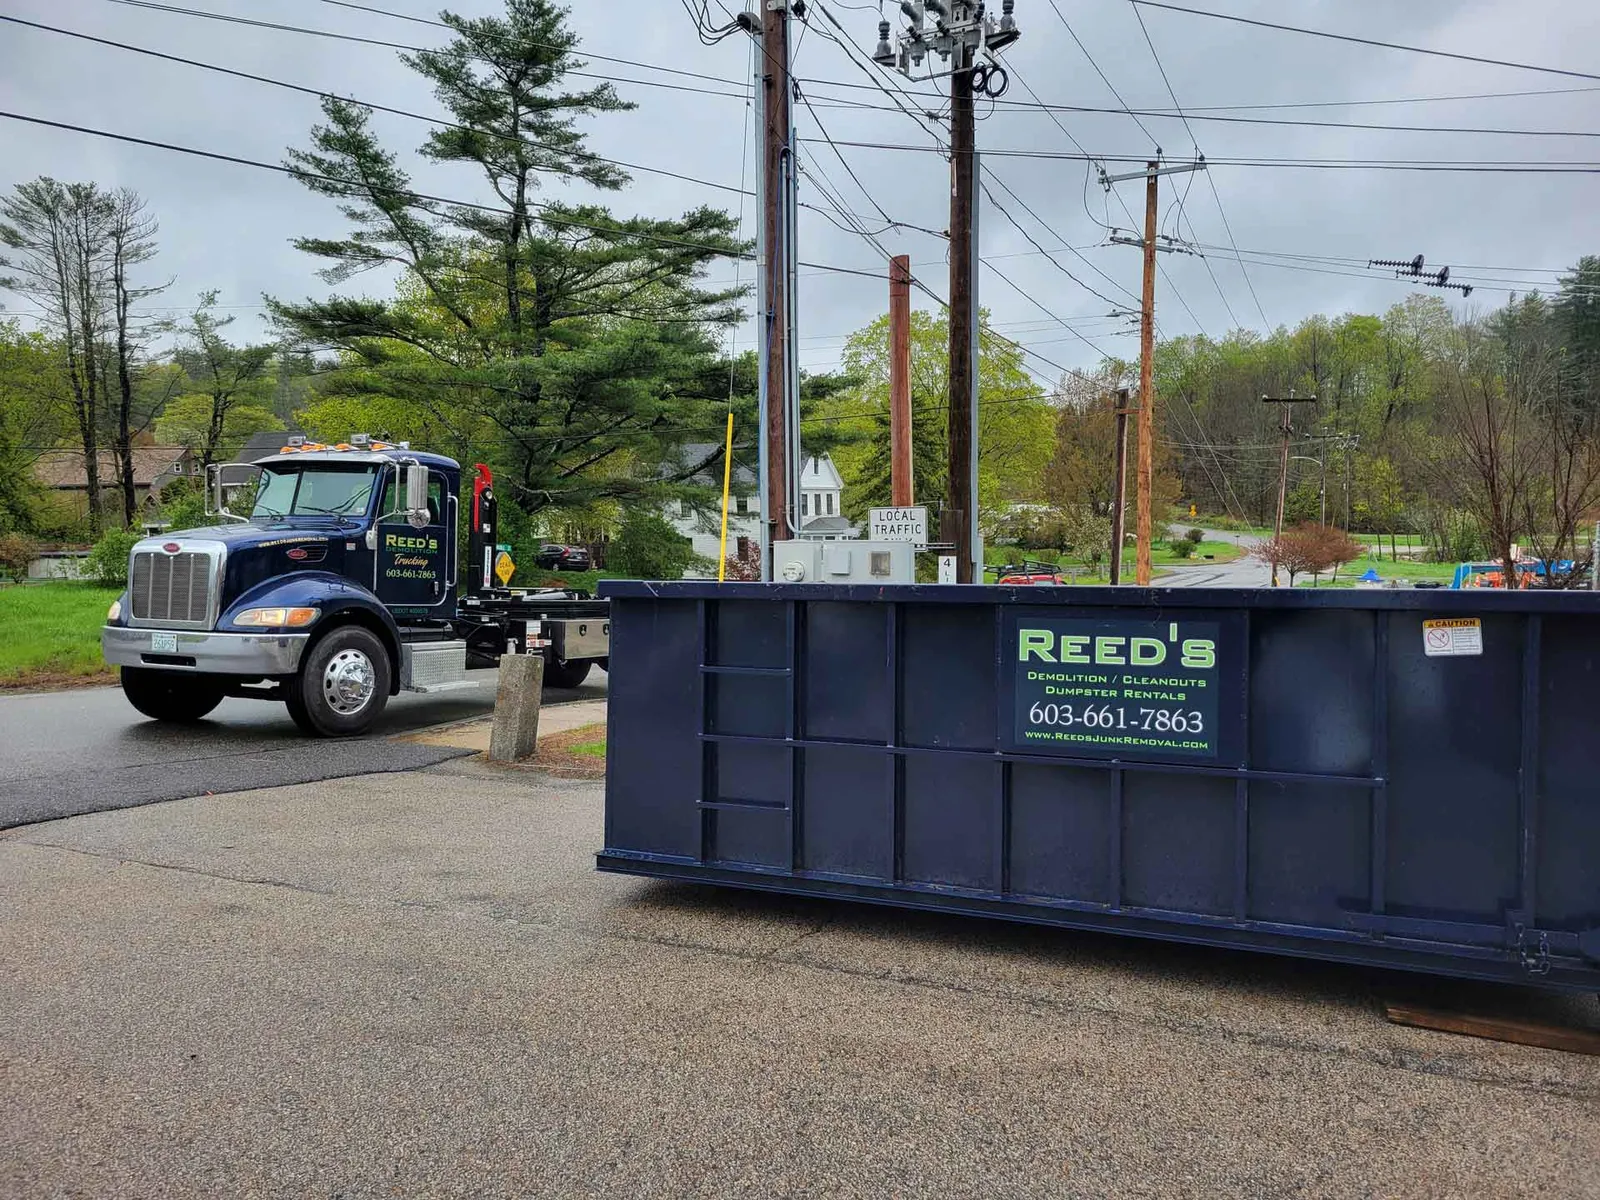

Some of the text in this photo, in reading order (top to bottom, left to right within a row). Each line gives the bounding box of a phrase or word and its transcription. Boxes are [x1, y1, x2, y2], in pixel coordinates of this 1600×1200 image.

[879, 510, 916, 521] LOCAL
[874, 523, 922, 535] TRAFFIC
[386, 534, 438, 549] REED'S
[385, 546, 438, 554] DEMOLITION
[394, 553, 428, 570] Trucking
[943, 558, 951, 567] 4
[386, 568, 437, 579] 603-661-7863
[1019, 622, 1216, 668] REED'S
[1027, 671, 1107, 683] DEMOLITION
[1122, 675, 1207, 687] CLEANOUTS
[1045, 686, 1186, 701] DUMPSTER RENTALS
[1029, 701, 1204, 733] 603-661-7863
